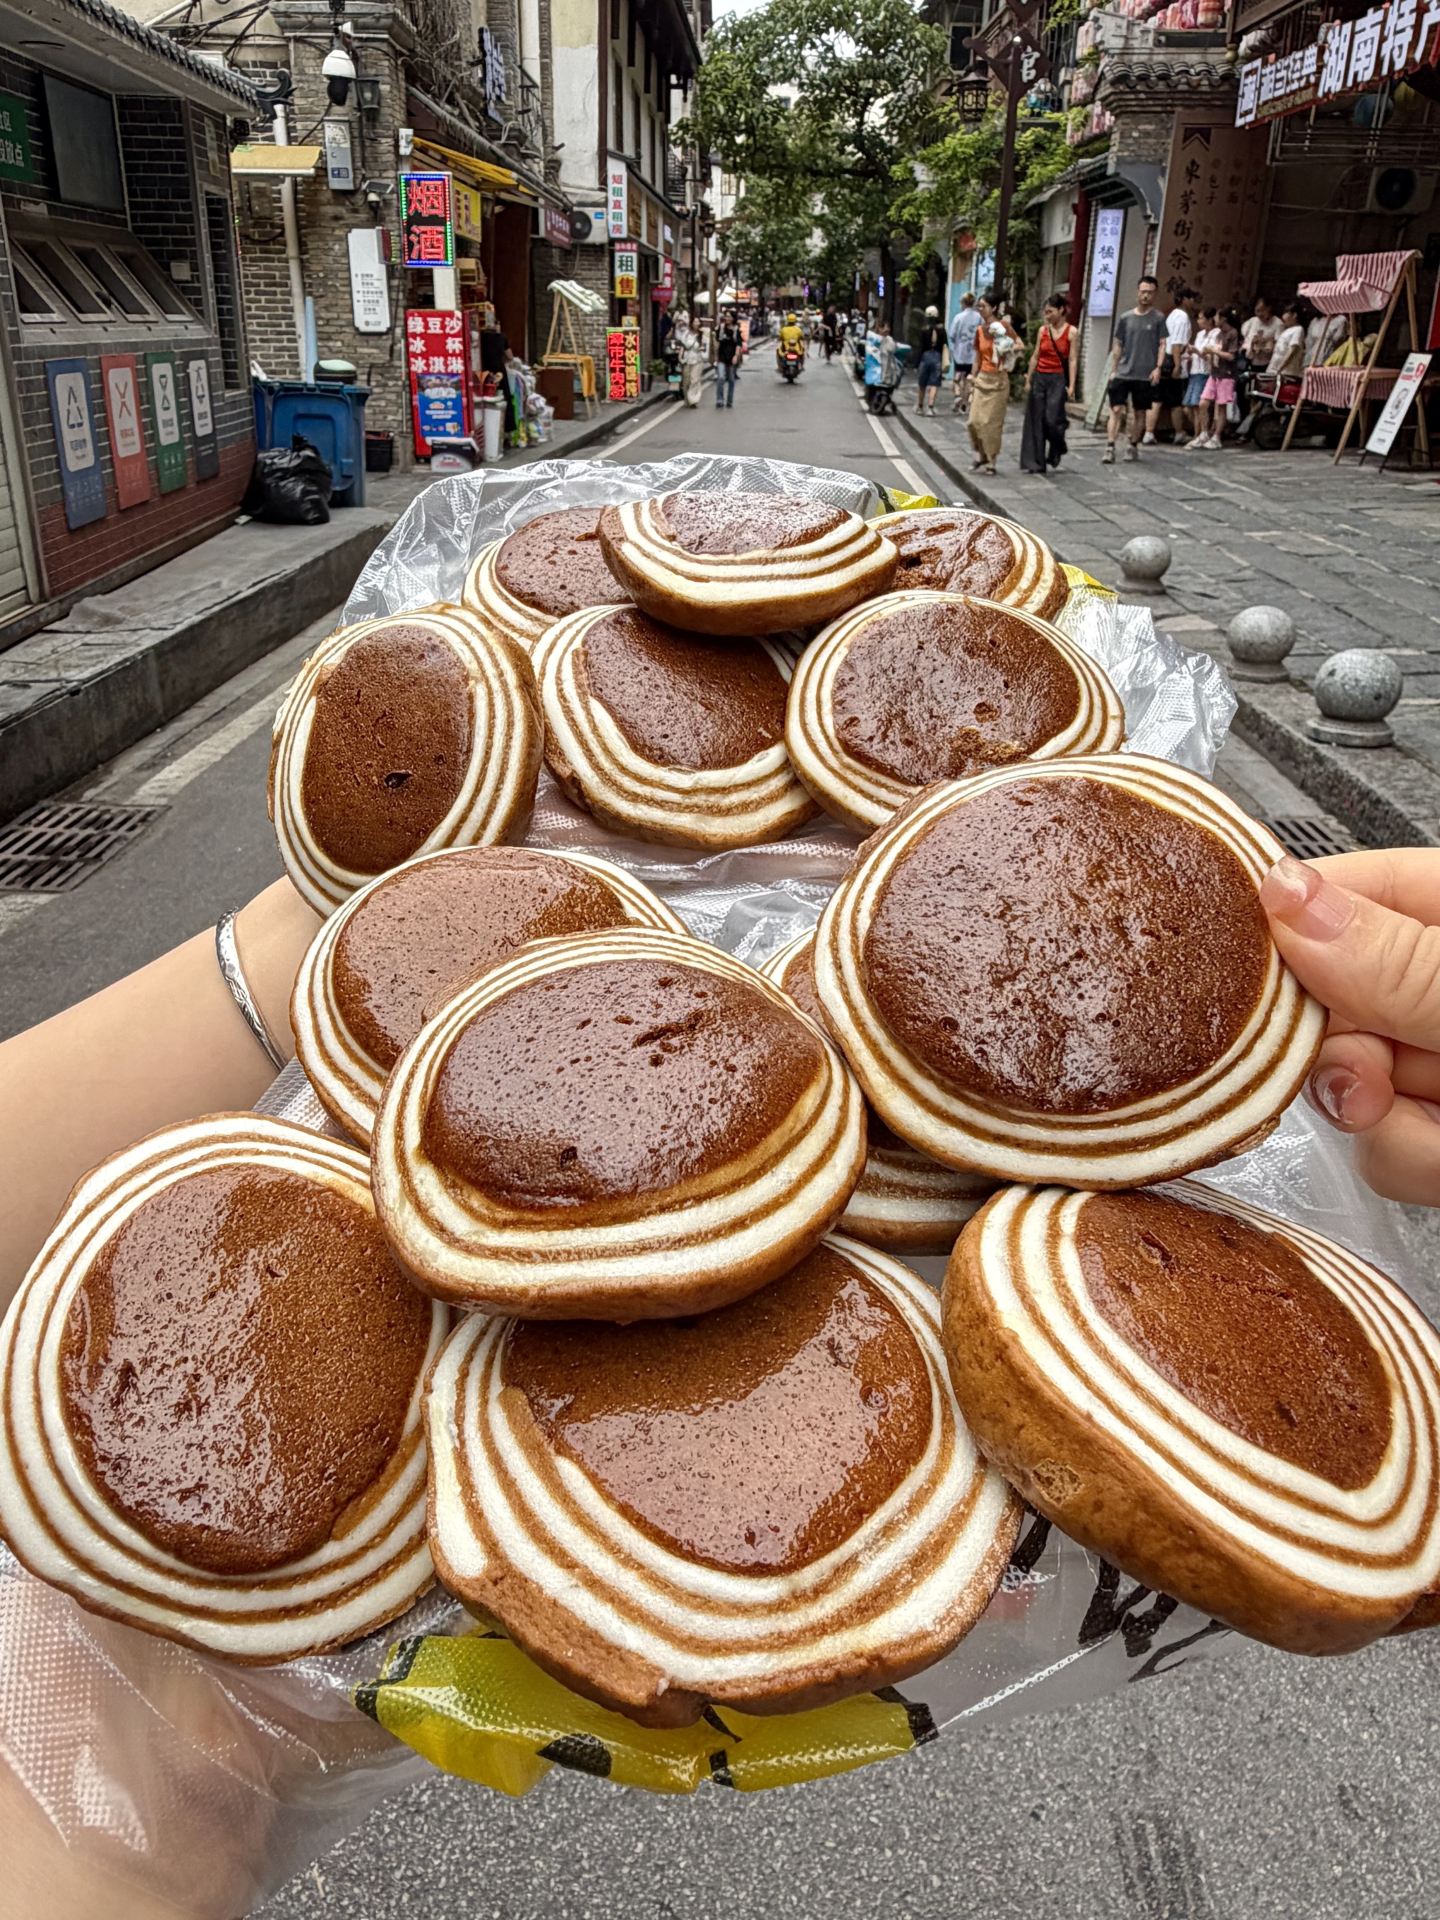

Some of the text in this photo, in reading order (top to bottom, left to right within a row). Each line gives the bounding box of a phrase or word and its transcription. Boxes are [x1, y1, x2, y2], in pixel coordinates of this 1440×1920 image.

[1317, 0, 1440, 99] 湖南特产
[407, 180, 446, 260] 烟酒
[407, 314, 462, 334] 绿豆沙
[409, 337, 463, 354] 冰 杯
[410, 356, 465, 374] 冰淇淋
